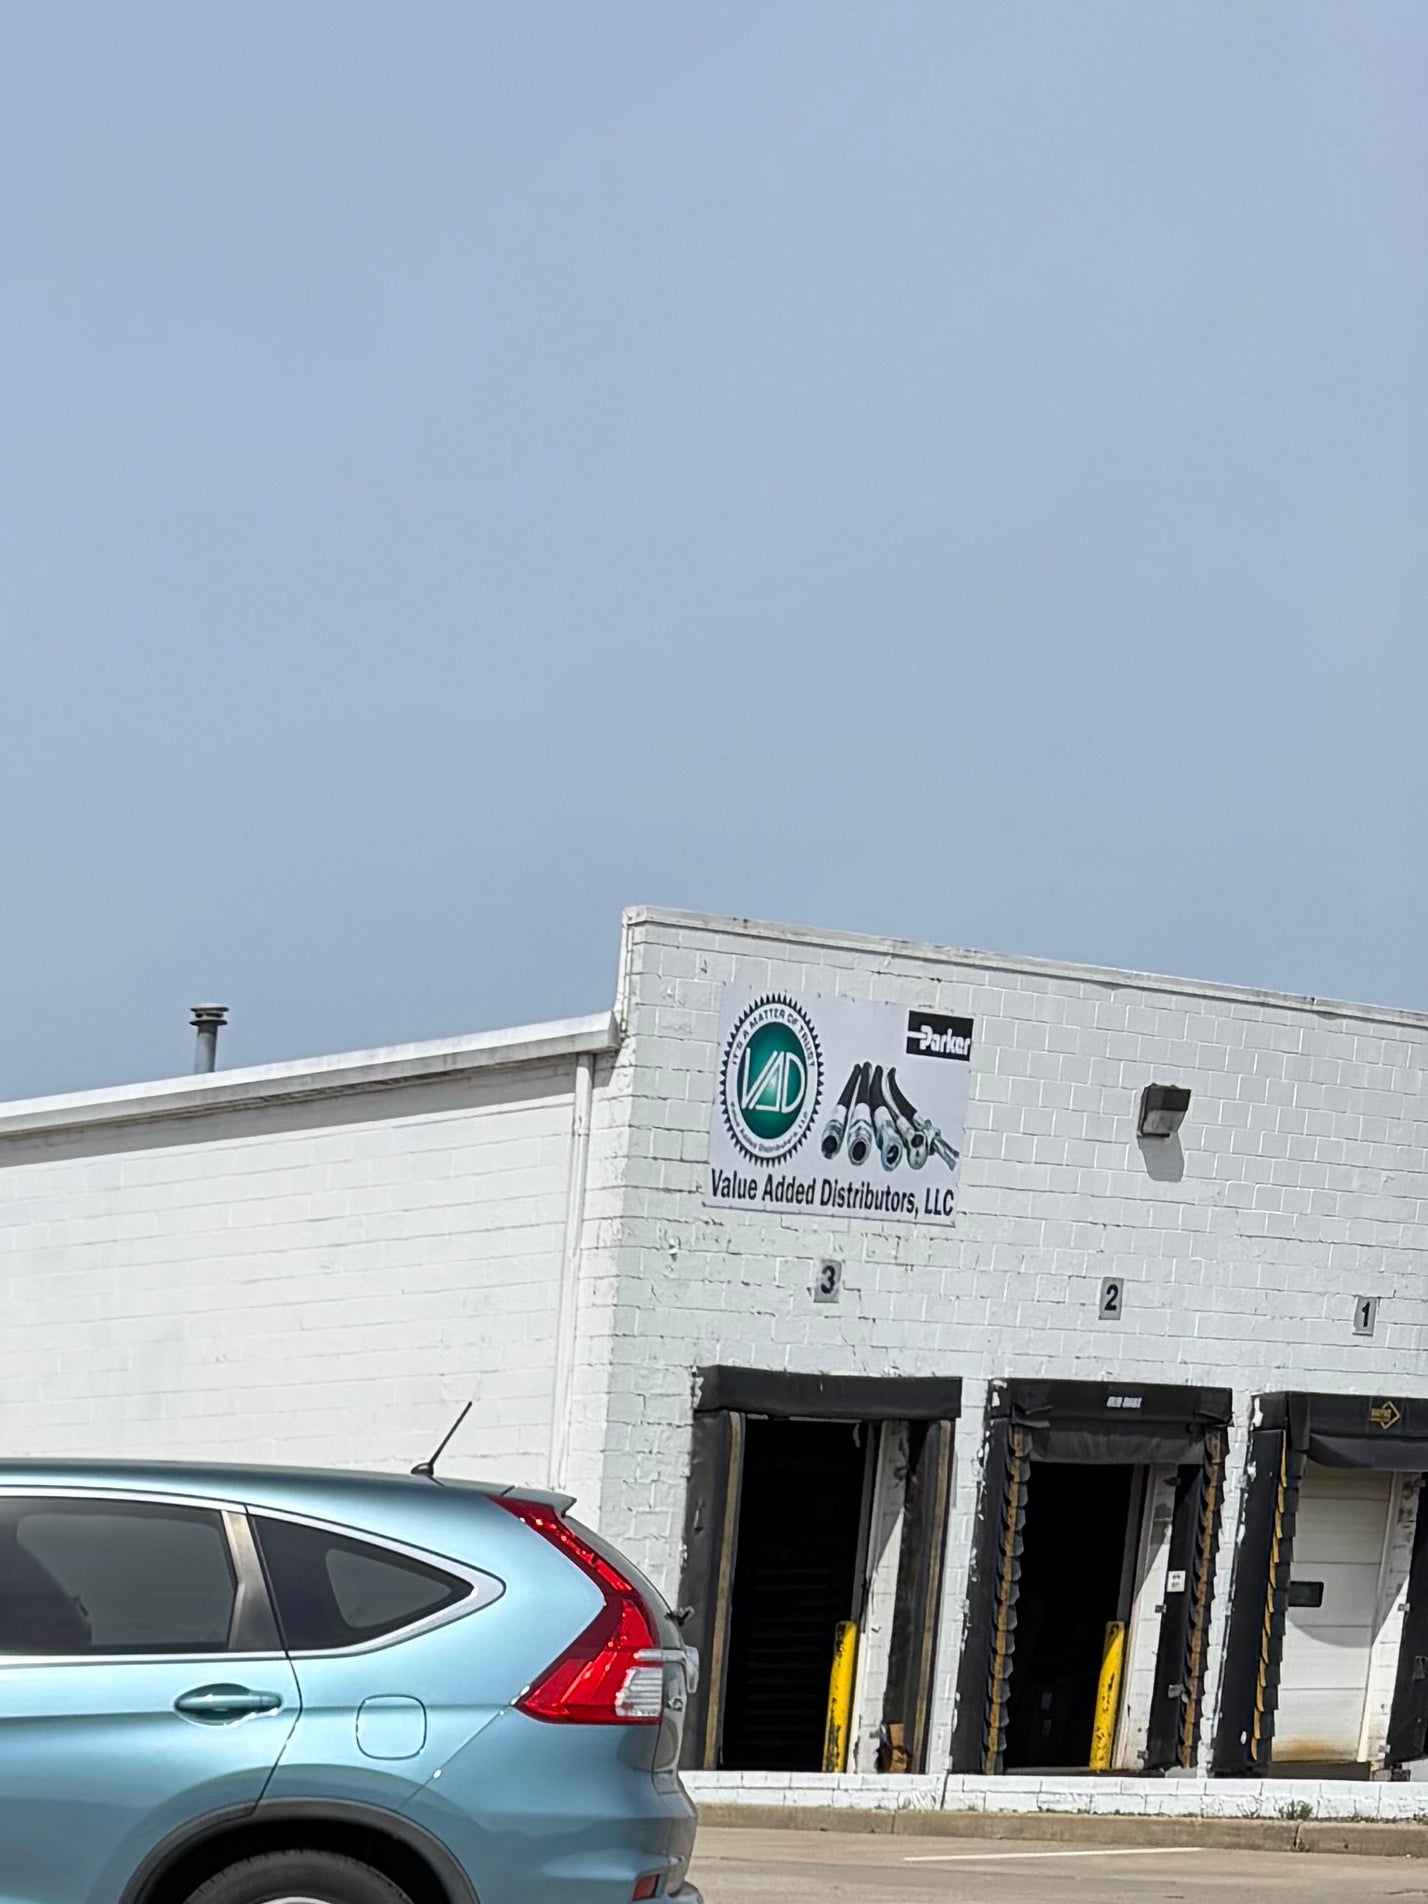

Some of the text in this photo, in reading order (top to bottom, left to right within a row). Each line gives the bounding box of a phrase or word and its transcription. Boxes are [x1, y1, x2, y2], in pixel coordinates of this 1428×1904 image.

[749, 1008, 786, 1030] MATTER
[787, 1013, 799, 1026] OF
[798, 1025, 816, 1067] TRUST
[920, 1025, 971, 1056] Parker
[711, 1168, 954, 1219] Value Added Distributors, LLC
[821, 1265, 836, 1294] 3
[1104, 1284, 1119, 1311] 2
[1361, 1301, 1370, 1328] 1
